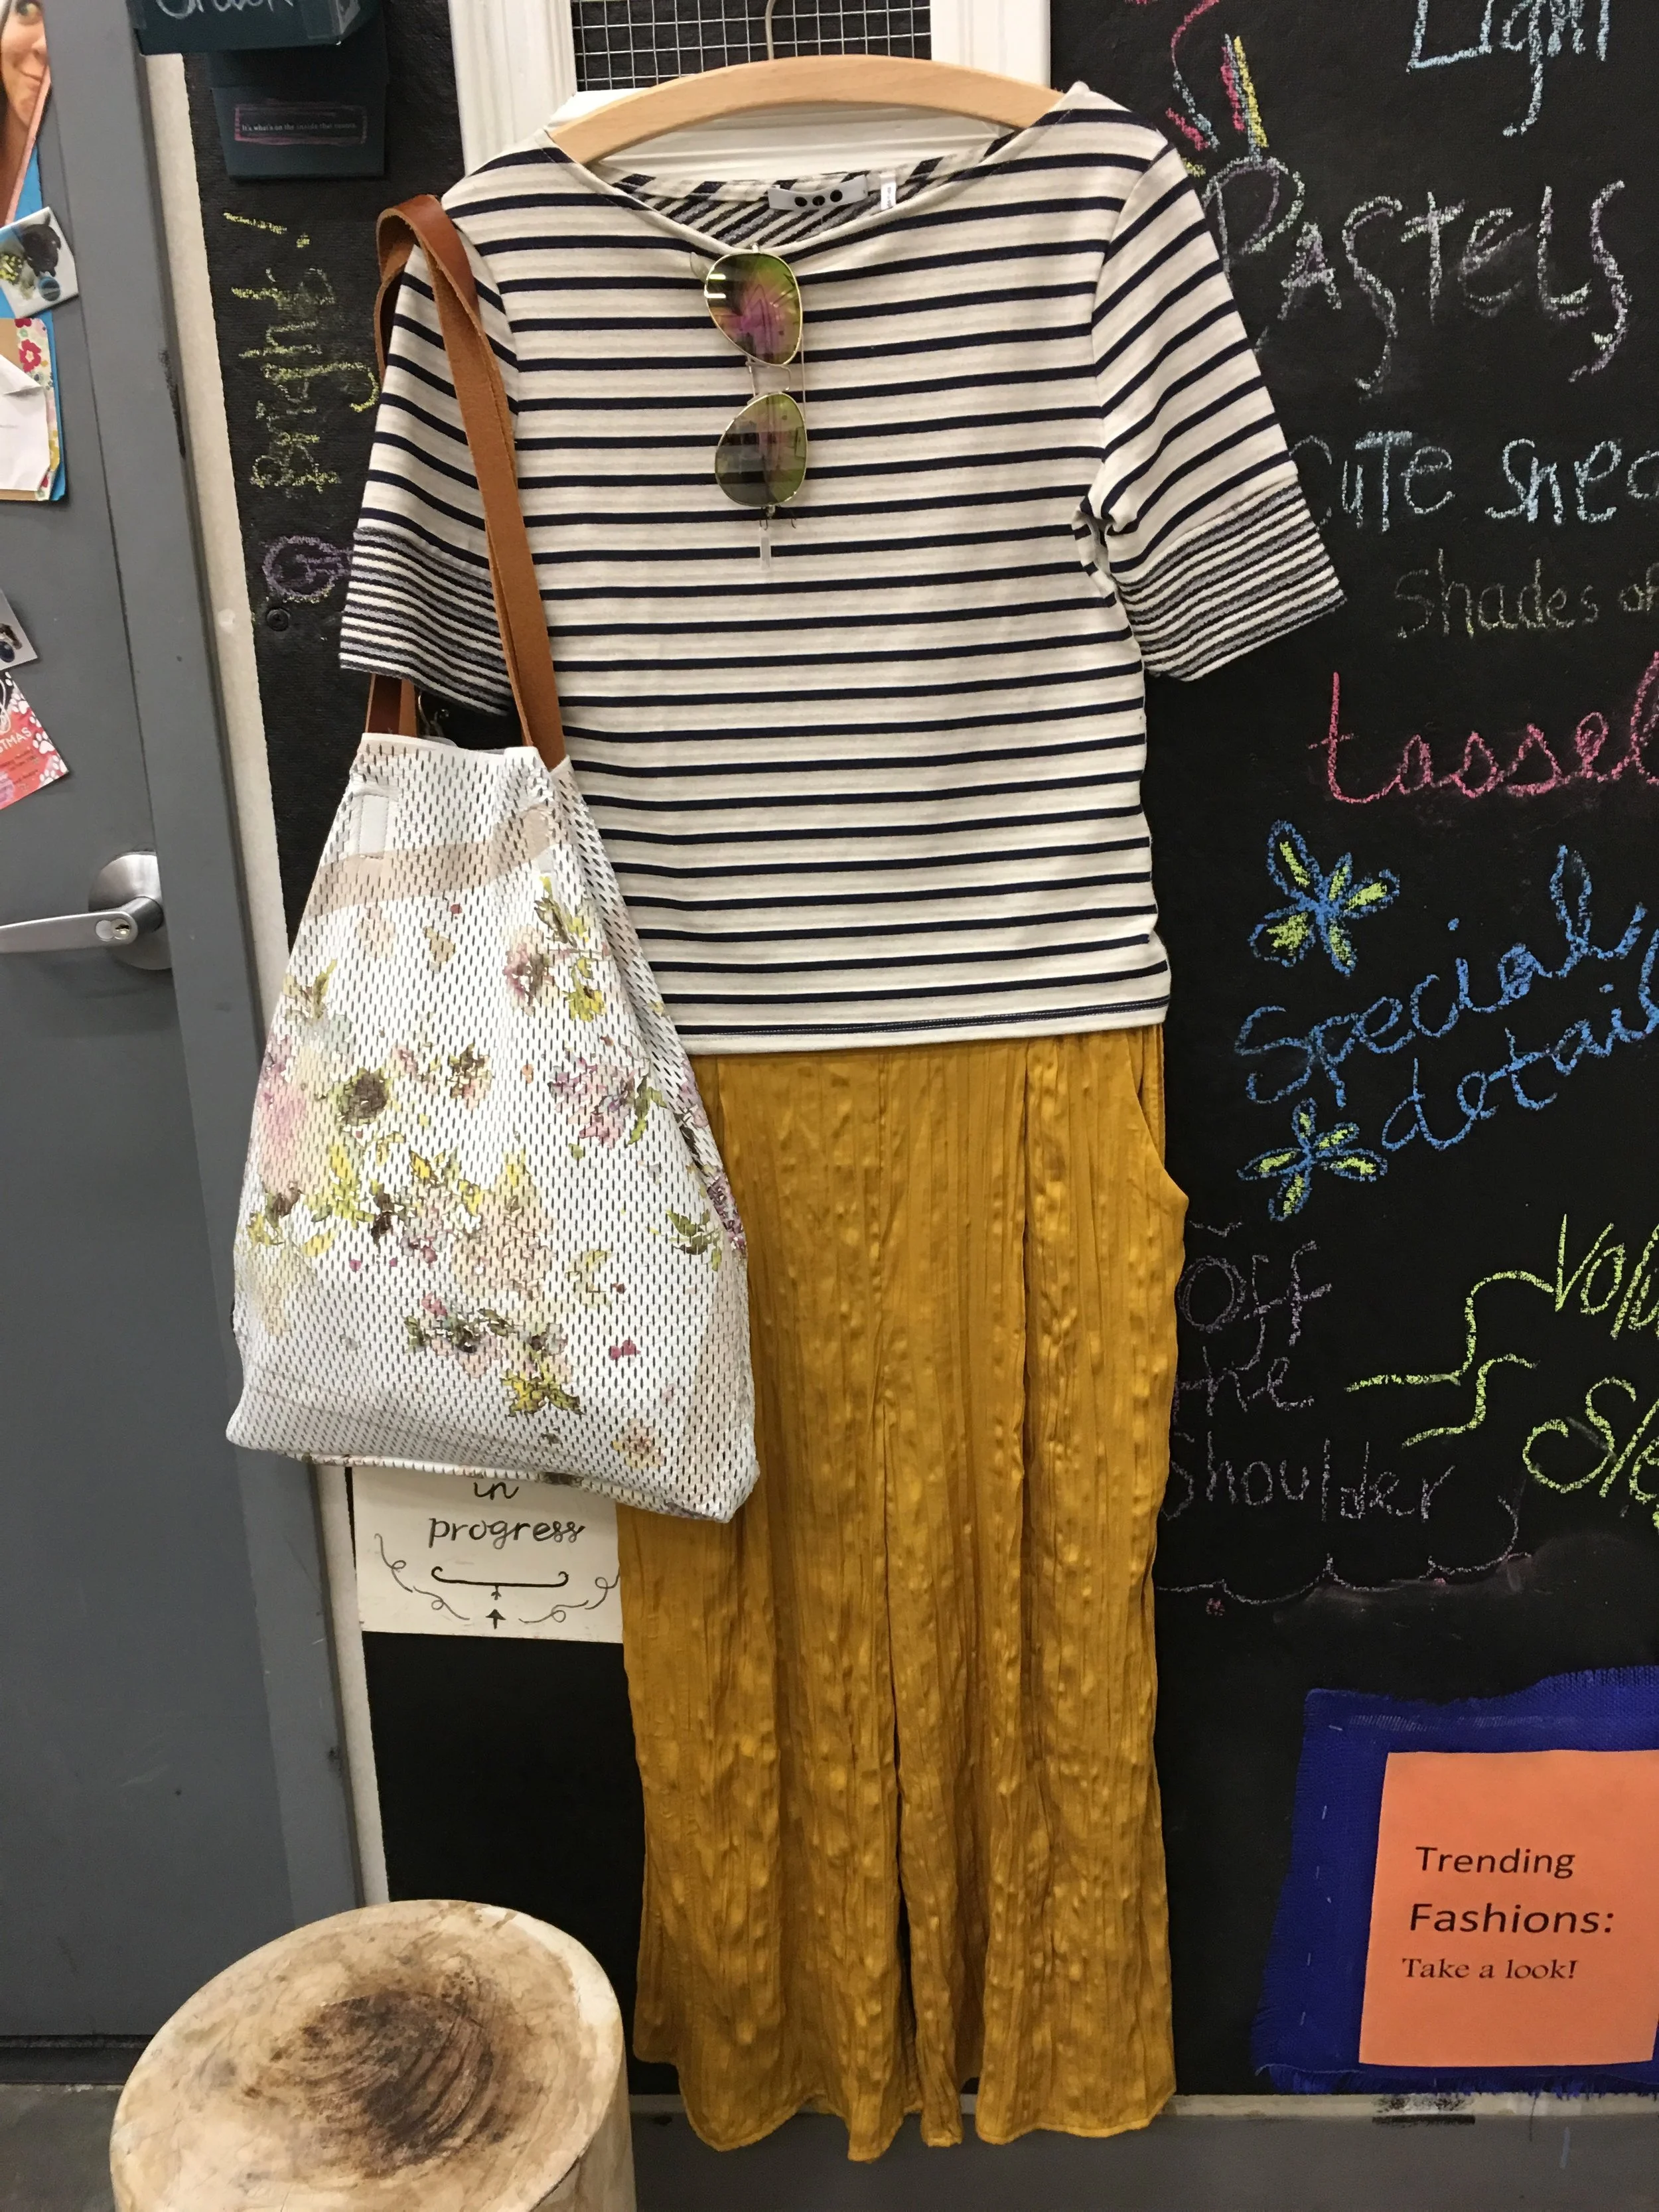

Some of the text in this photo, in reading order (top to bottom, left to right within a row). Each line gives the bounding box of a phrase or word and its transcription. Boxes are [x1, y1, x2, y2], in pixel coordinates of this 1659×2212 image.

[472, 1481, 519, 1500] in
[428, 1517, 586, 1550] progress
[1415, 1846, 1576, 1880] Trending
[1409, 1902, 1615, 1935] Fashions:
[1402, 1958, 1579, 1980] Take a look!
